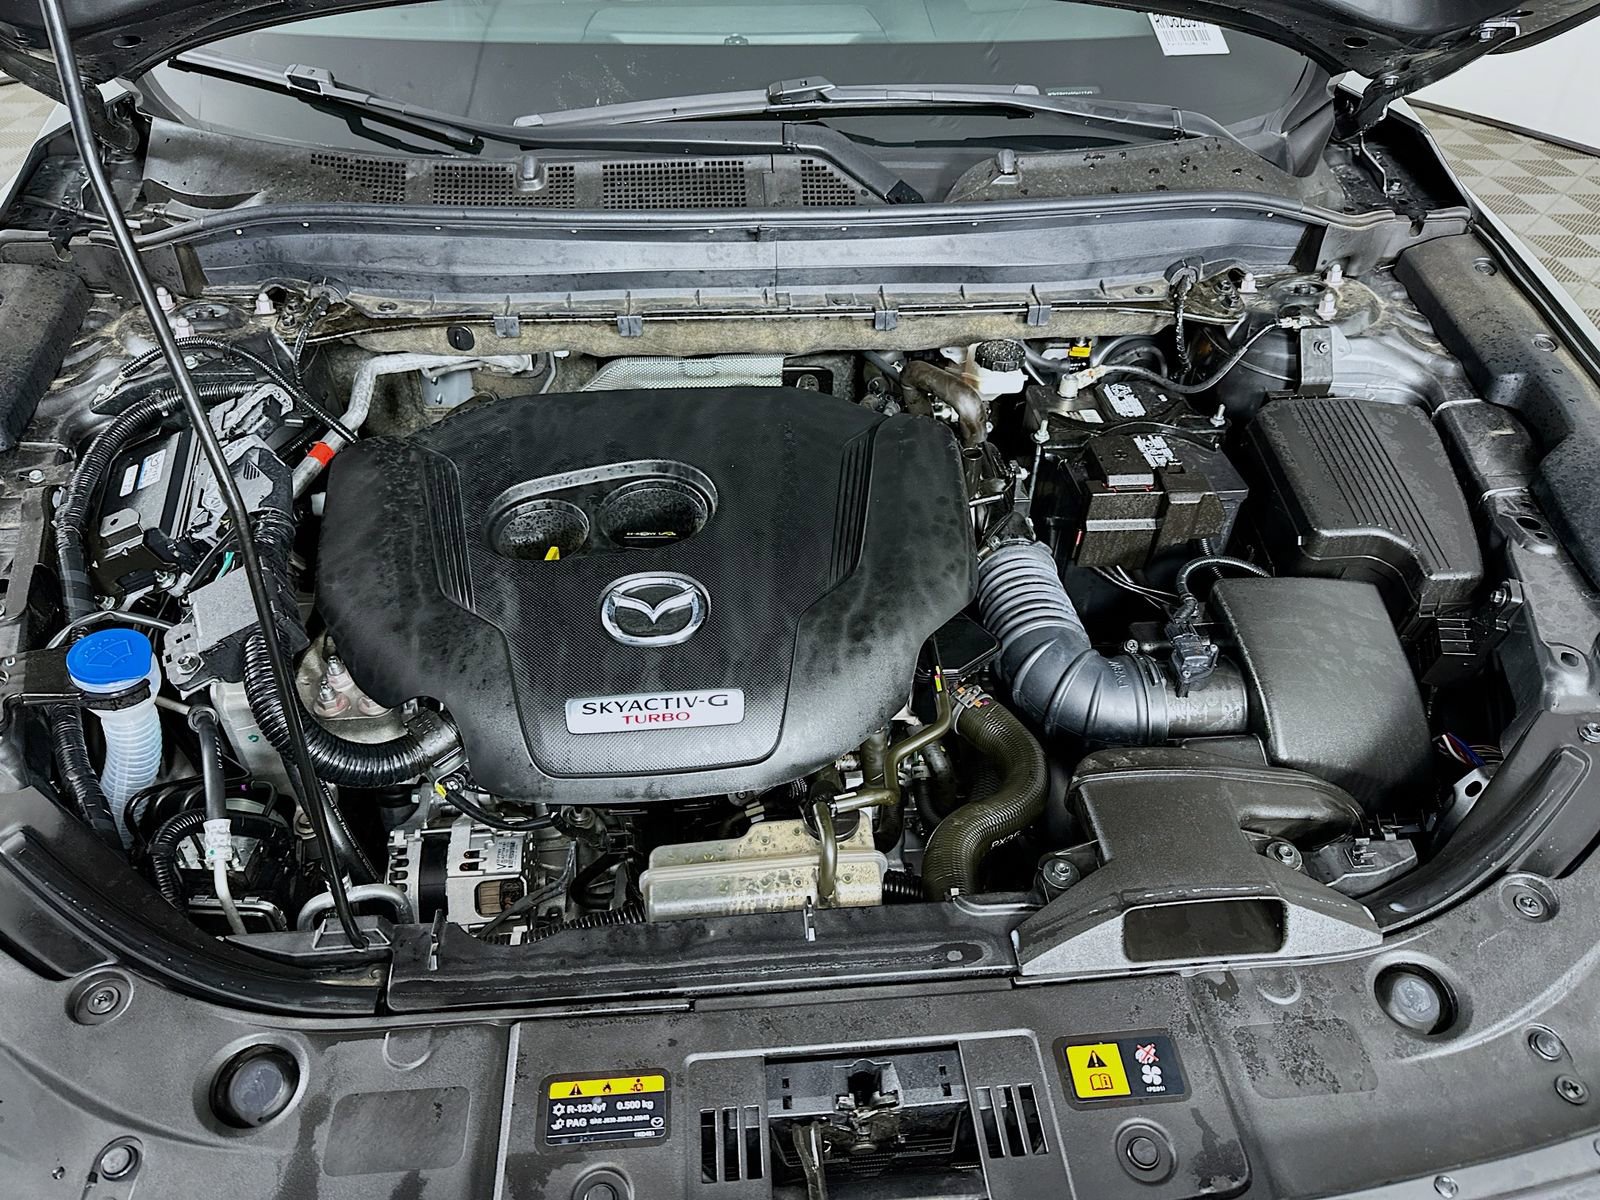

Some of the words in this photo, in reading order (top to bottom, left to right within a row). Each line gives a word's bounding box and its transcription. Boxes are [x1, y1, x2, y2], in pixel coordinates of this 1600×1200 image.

[581, 694, 729, 715] SKYACTIV-G
[622, 711, 691, 725] TURBO
[616, 1100, 641, 1111] 0.500
[641, 1099, 654, 1110] kg
[566, 1118, 588, 1128] PAG
